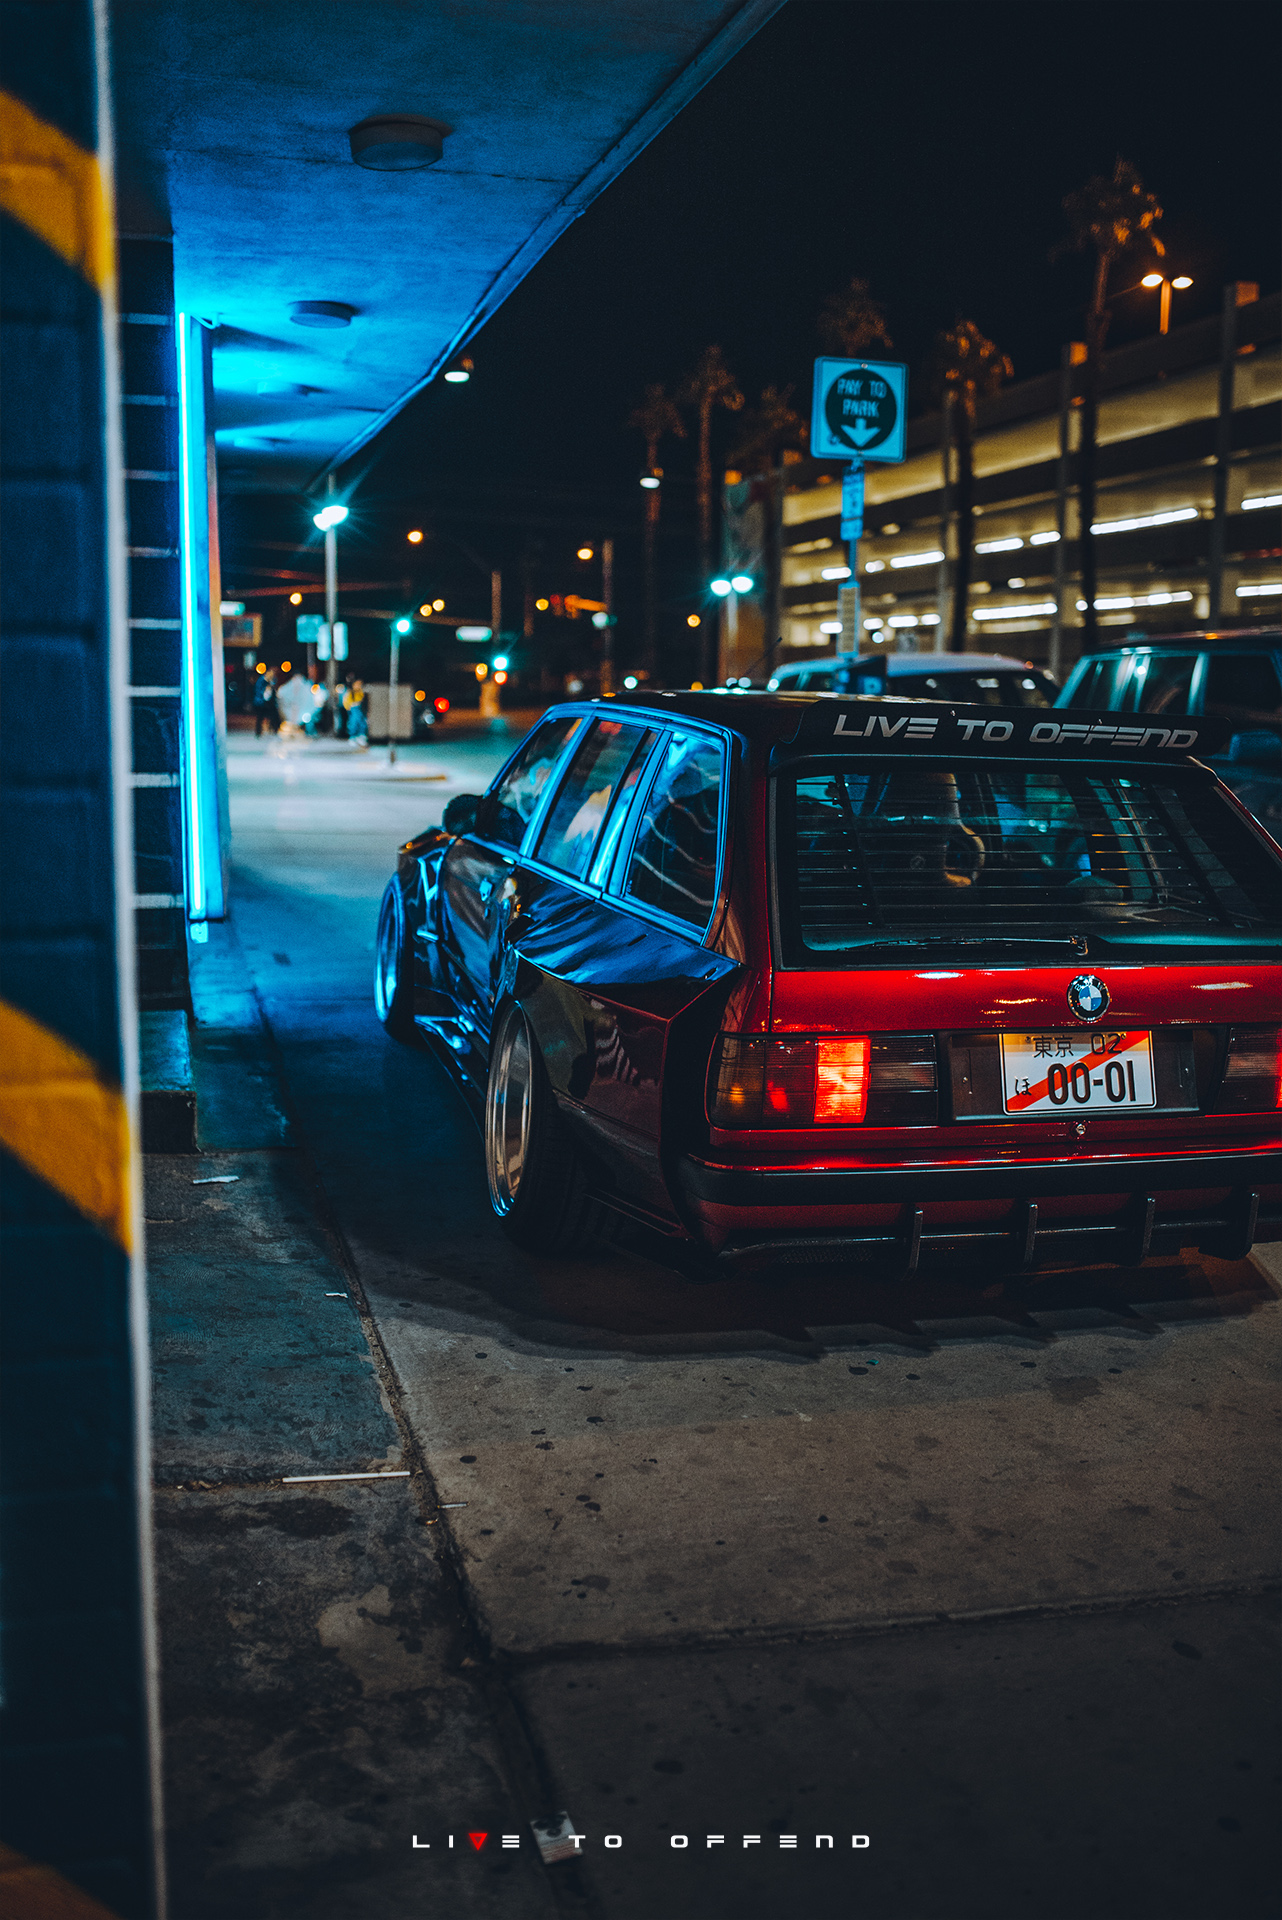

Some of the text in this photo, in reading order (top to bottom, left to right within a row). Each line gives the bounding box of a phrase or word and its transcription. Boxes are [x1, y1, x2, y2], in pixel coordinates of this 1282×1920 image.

[837, 378, 887, 399] PAY TO
[842, 398, 880, 418] PARK
[833, 714, 1199, 748] LIVE TO OFFEND
[1033, 1033, 1122, 1058] 東京 02
[1014, 1060, 1136, 1105] ほ 00-01
